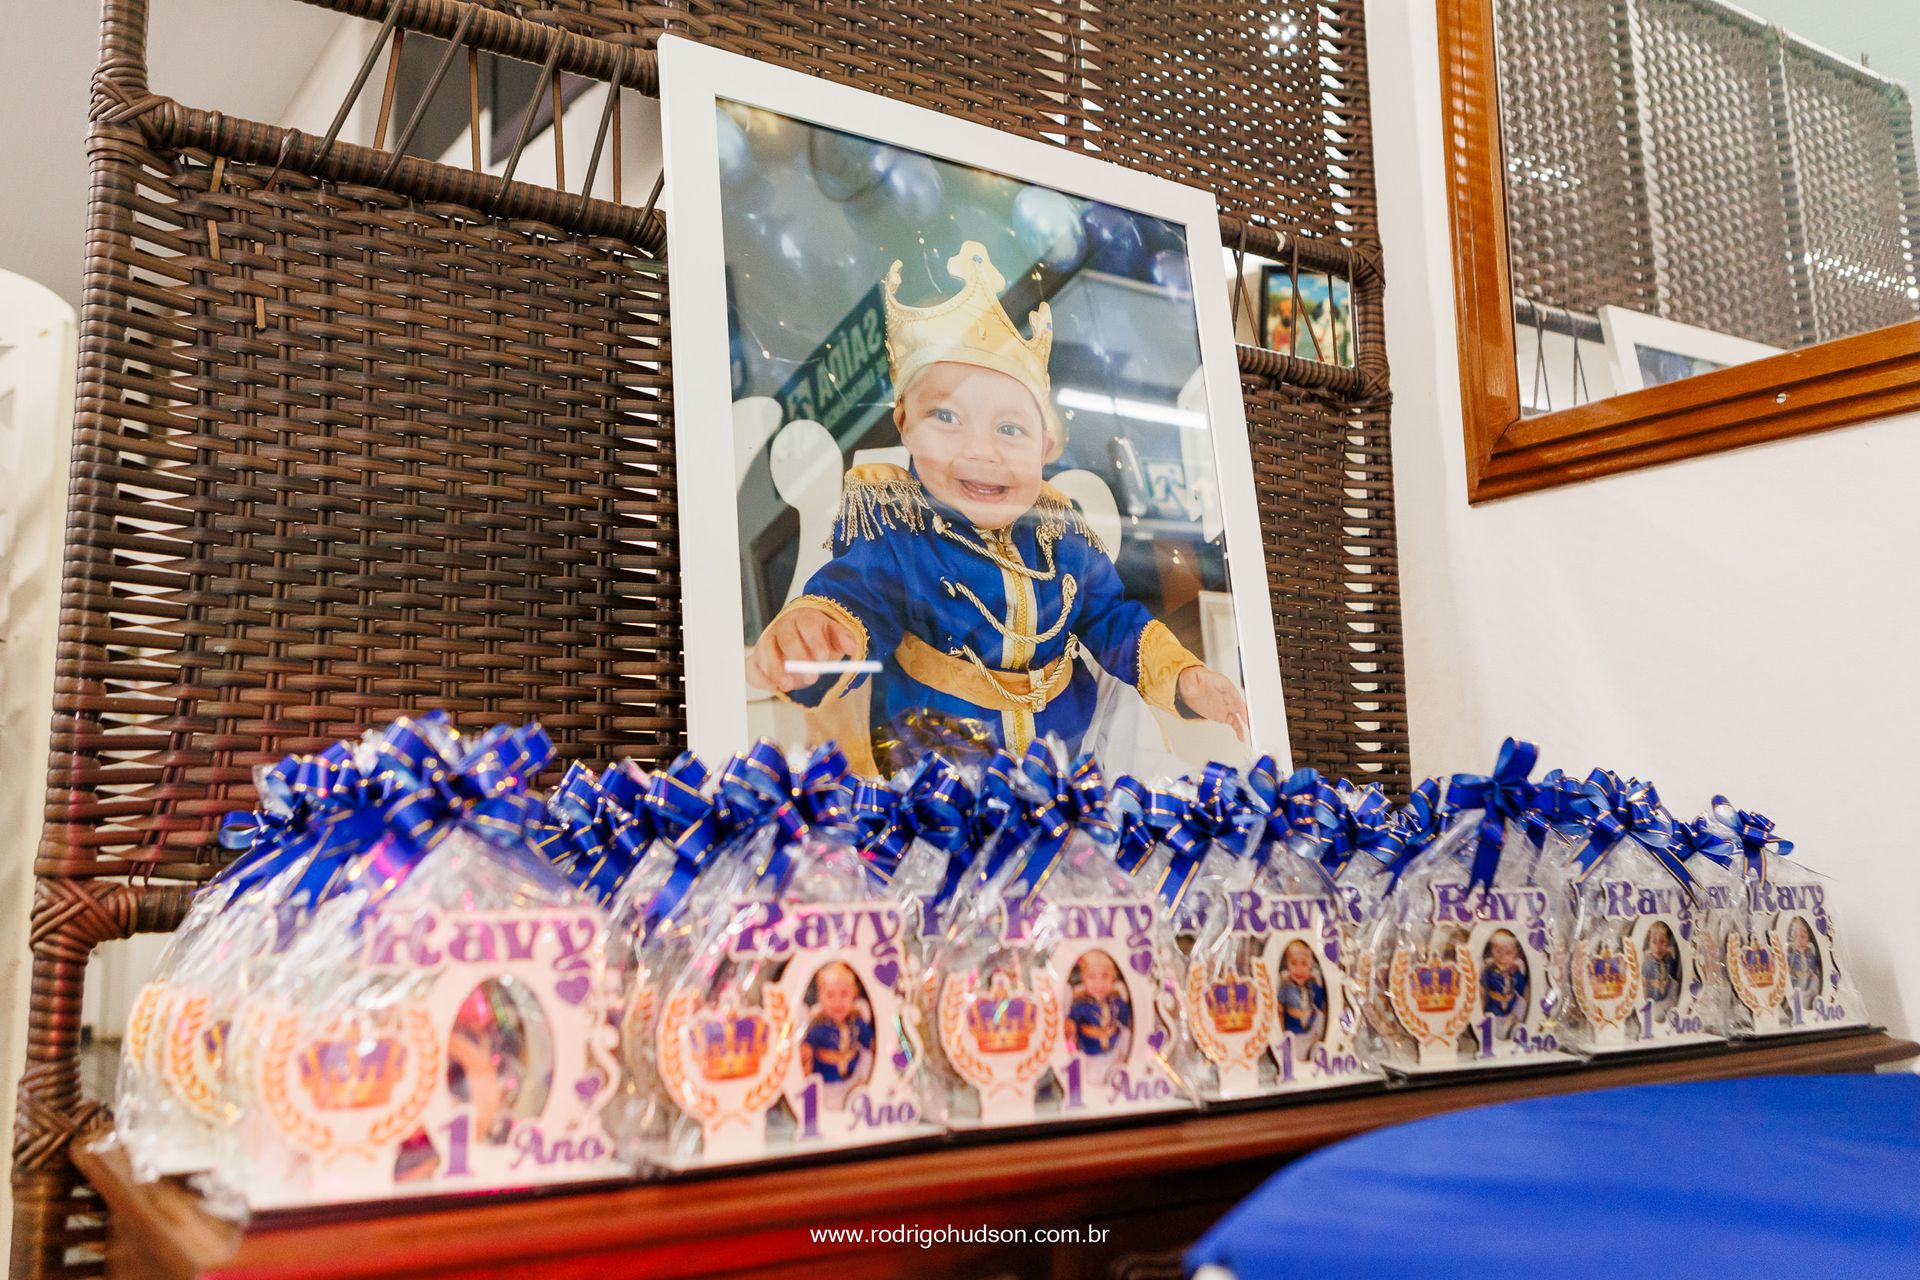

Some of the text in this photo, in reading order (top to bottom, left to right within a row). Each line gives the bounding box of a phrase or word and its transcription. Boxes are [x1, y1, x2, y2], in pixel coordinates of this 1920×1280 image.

[1434, 882, 1547, 930] Ravy
[1751, 880, 1824, 917] Ravy
[1640, 1001, 1654, 1040] 1
[1792, 993, 1804, 1024] 1
[1278, 1037, 1358, 1081] 1 Ano
[1478, 1016, 1557, 1058] 1 Ano
[1064, 1058, 1085, 1108] 1
[798, 1083, 916, 1138] 1 Ano
[439, 1115, 472, 1178] 1
